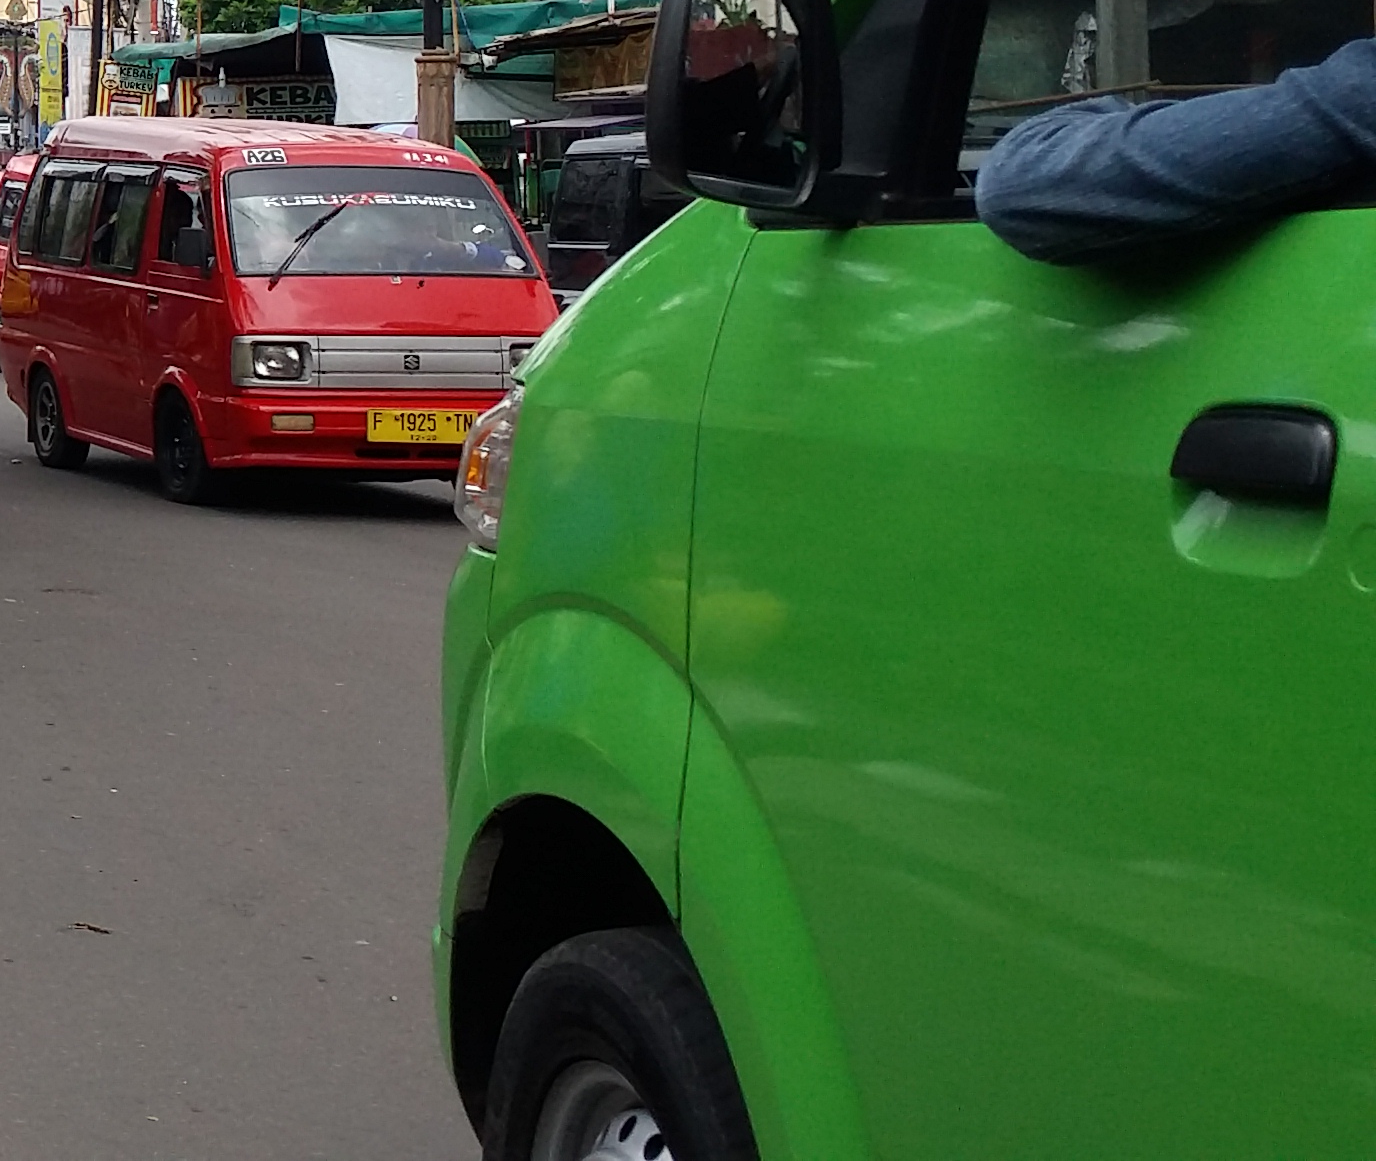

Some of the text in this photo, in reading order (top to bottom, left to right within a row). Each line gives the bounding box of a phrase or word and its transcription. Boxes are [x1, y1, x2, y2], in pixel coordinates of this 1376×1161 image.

[119, 66, 155, 80] KEBAB
[119, 80, 153, 92] TURKEY
[245, 85, 334, 107] KEBA
[247, 149, 286, 164] A26
[373, 412, 473, 433] F 1925 TN
